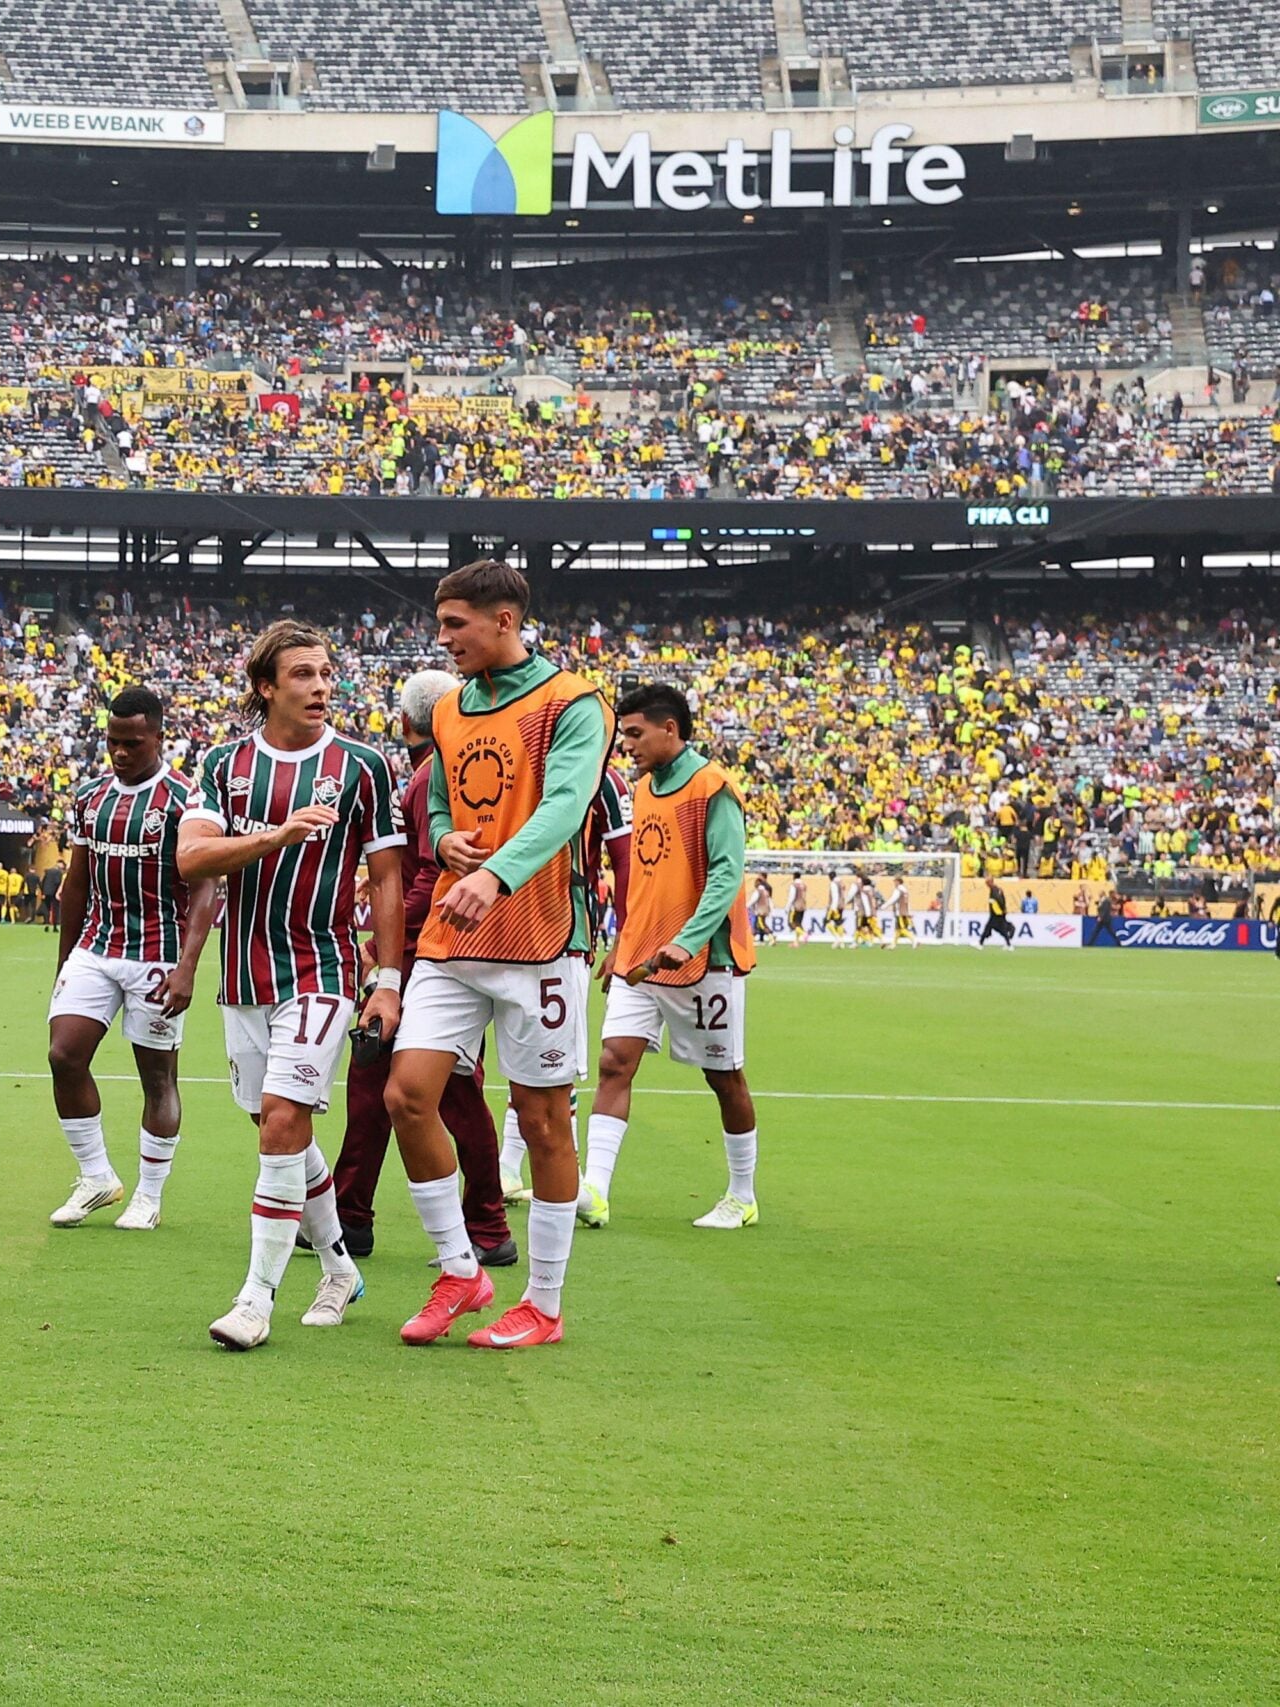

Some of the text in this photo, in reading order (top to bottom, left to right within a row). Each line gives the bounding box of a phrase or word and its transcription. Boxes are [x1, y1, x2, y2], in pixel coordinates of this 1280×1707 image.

[9, 112, 165, 133] WEEB EWBANK
[569, 122, 967, 211] MetLife
[967, 507, 1013, 525] FIFA
[457, 736, 497, 760] WORLD
[499, 743, 514, 766] CUP
[504, 774, 515, 790] 25
[477, 814, 495, 824] FIFA
[87, 837, 160, 858] SUPERBET
[1115, 920, 1231, 947] Michelob
[540, 977, 567, 1030] 5
[692, 994, 728, 1031] 12
[294, 995, 340, 1046] 17
[540, 1061, 564, 1069] umbro
[292, 1074, 315, 1087] umbro
